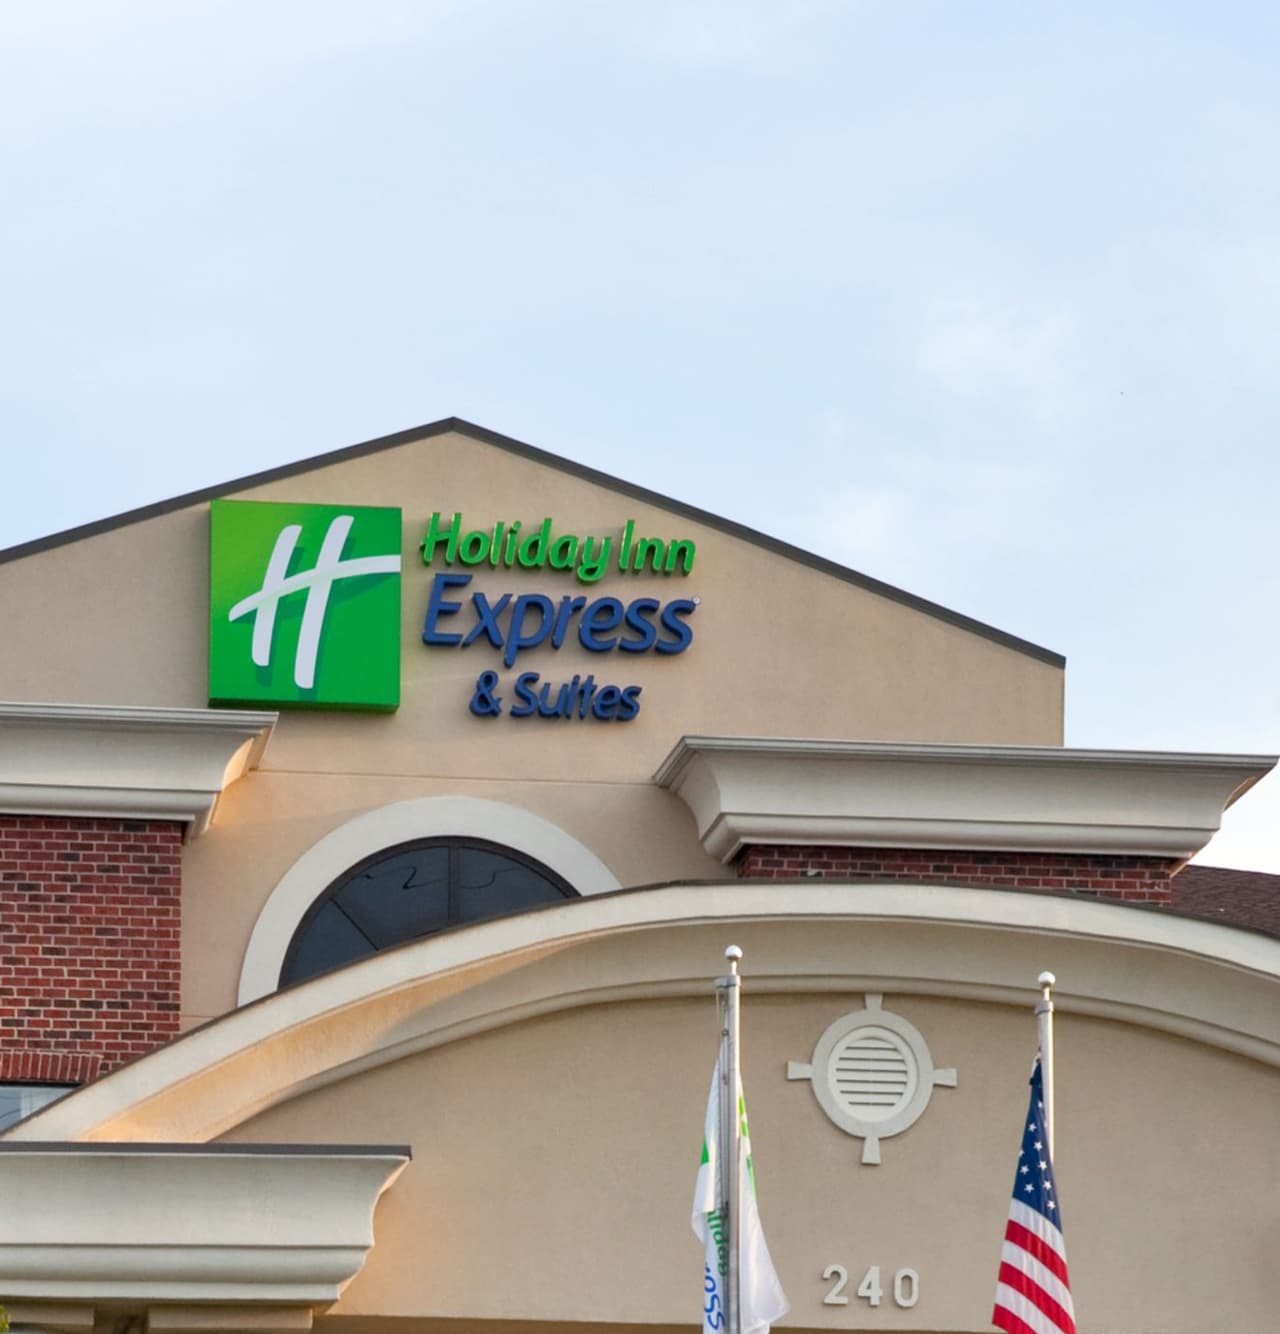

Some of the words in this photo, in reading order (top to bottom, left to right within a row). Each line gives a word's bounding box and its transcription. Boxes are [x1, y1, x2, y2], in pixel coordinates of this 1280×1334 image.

[419, 511, 612, 585] Holiday
[618, 519, 696, 576] Inn
[422, 572, 694, 669] Express
[468, 670, 502, 718] &
[510, 671, 643, 721] Suites
[822, 1263, 920, 1308] 240
